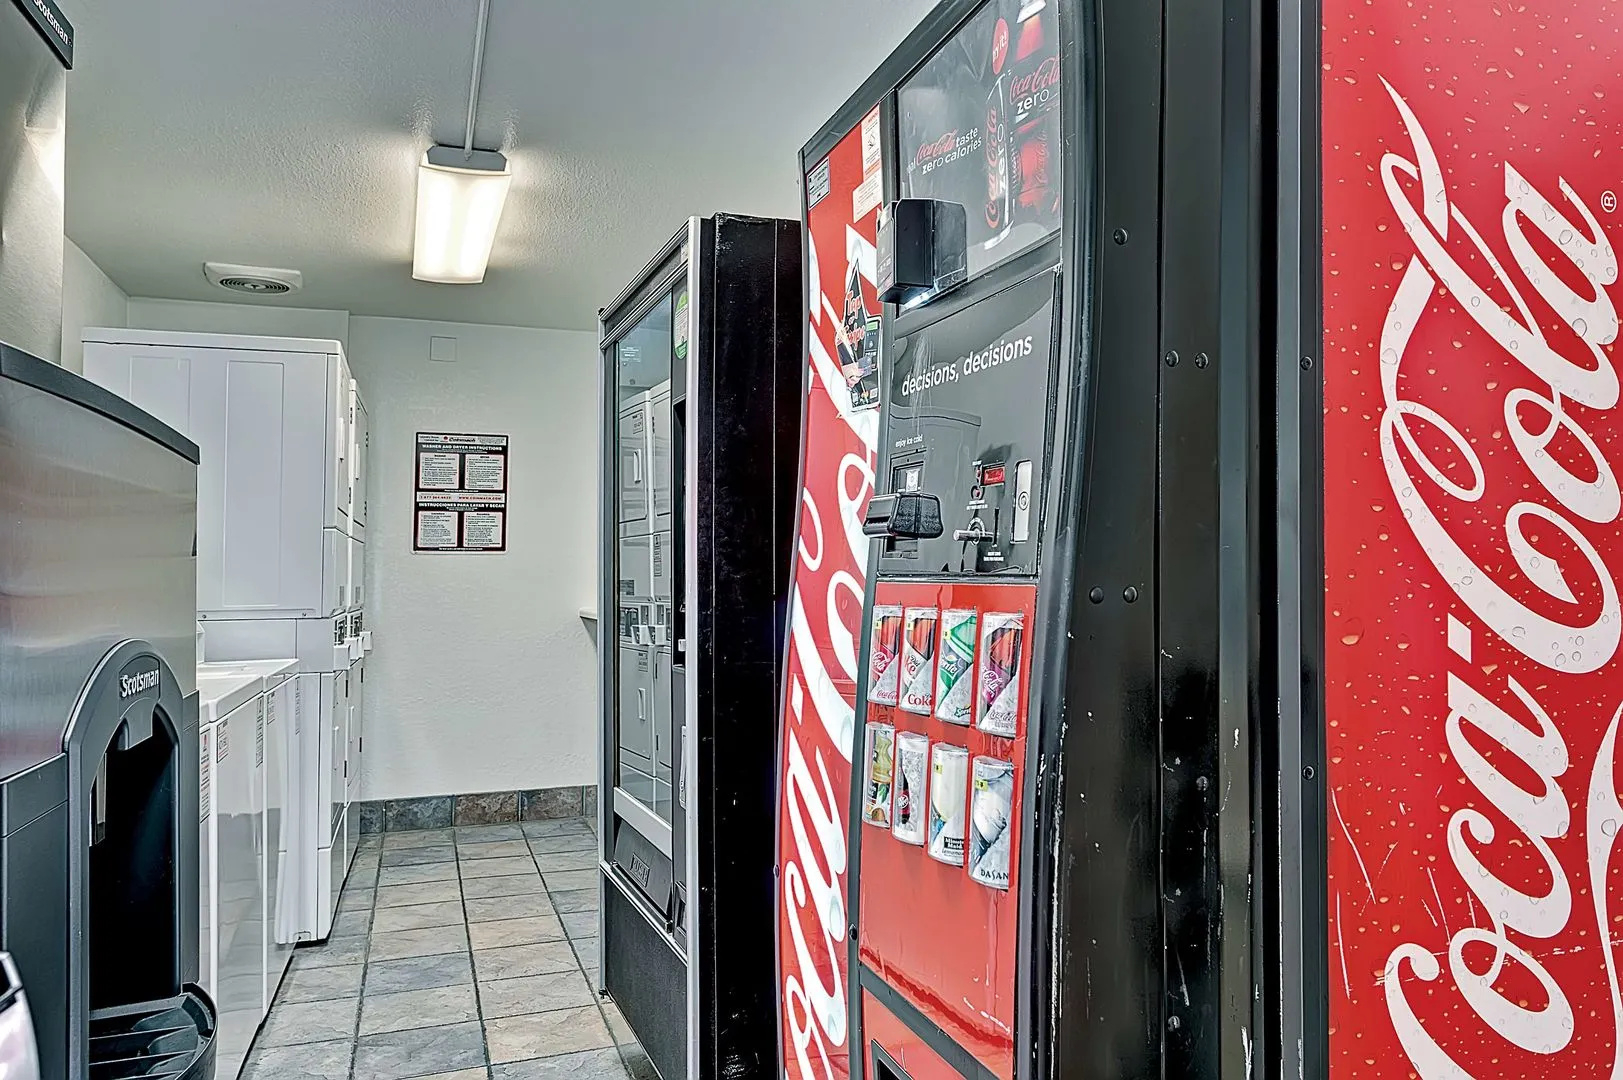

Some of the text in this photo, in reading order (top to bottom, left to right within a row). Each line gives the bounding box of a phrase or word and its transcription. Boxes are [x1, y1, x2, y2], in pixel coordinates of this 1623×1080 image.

[1017, 88, 1050, 114] zero
[956, 127, 978, 148] taste
[922, 136, 982, 175] zero calories
[997, 123, 1006, 193] zero
[901, 335, 1033, 396] decisions, decisions
[120, 669, 159, 698] Scotsman
[980, 868, 1009, 880] DASAN
